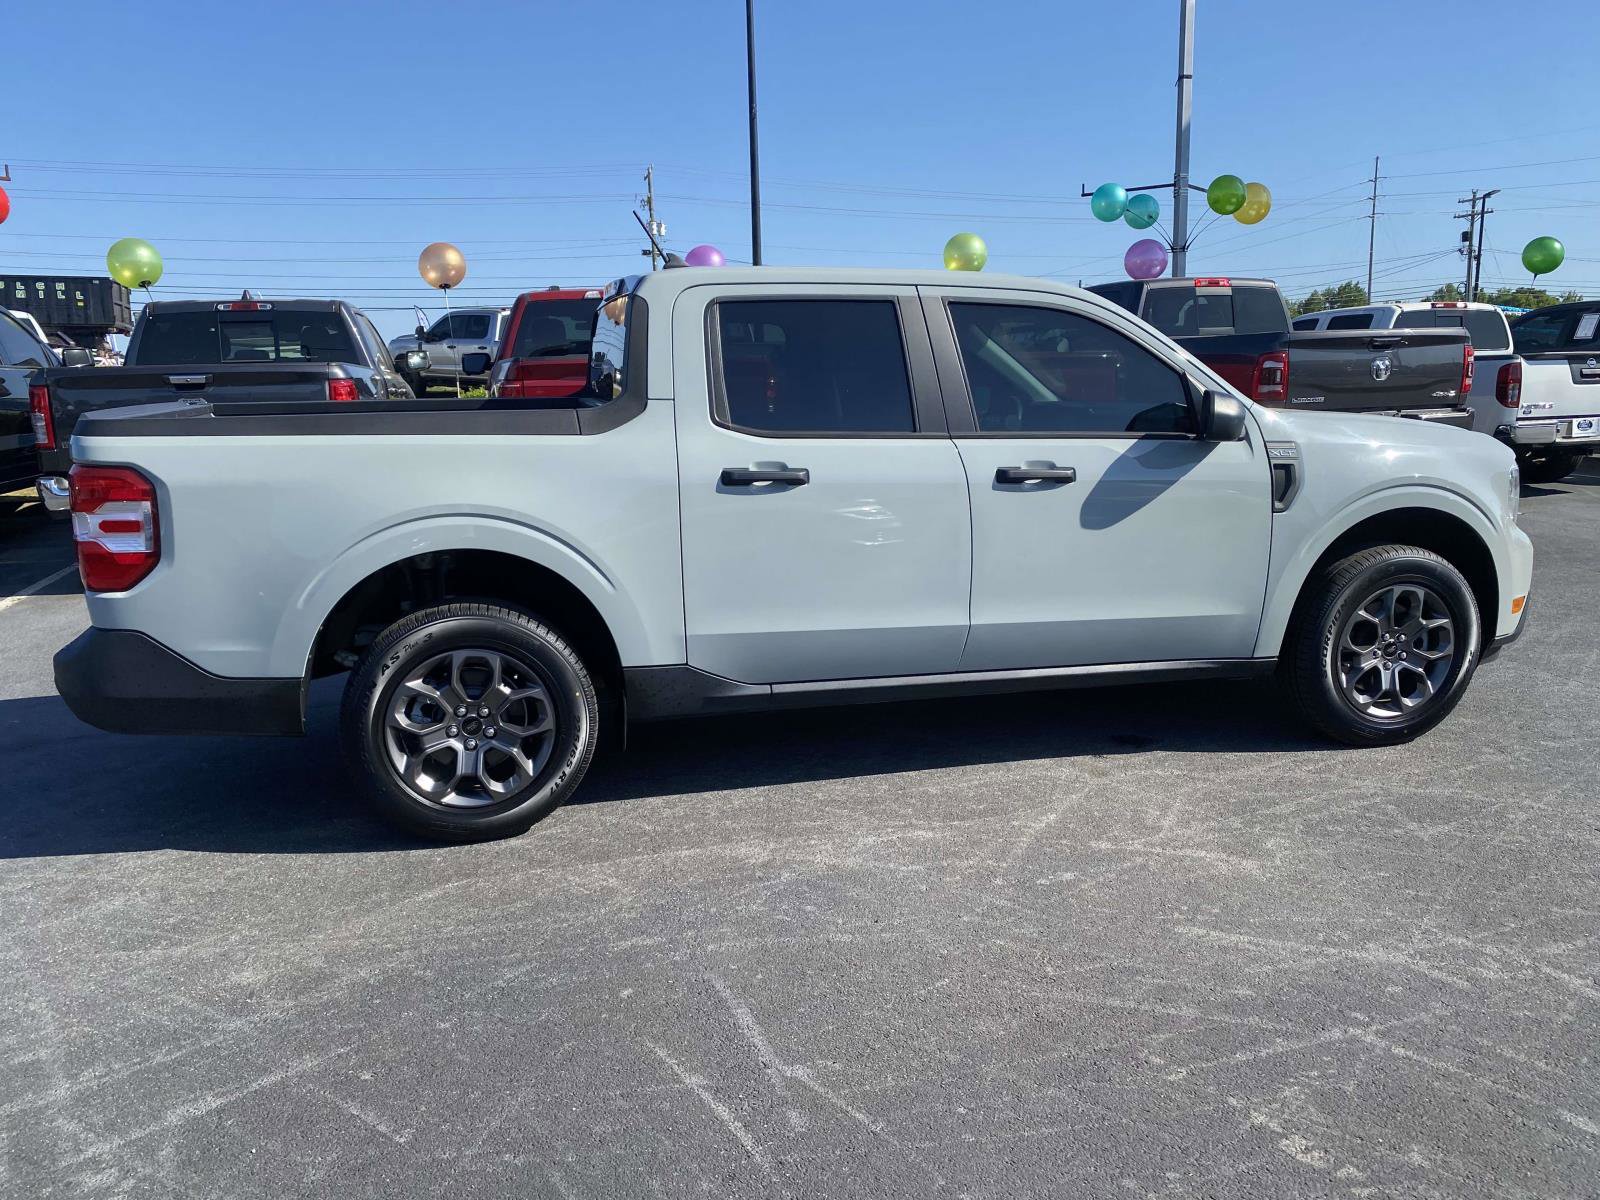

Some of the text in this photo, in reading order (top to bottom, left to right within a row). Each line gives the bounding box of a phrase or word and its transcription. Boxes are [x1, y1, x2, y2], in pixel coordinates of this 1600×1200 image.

[16, 290, 84, 299] MILL
[381, 651, 401, 676] AS
[423, 632, 433, 643] 3
